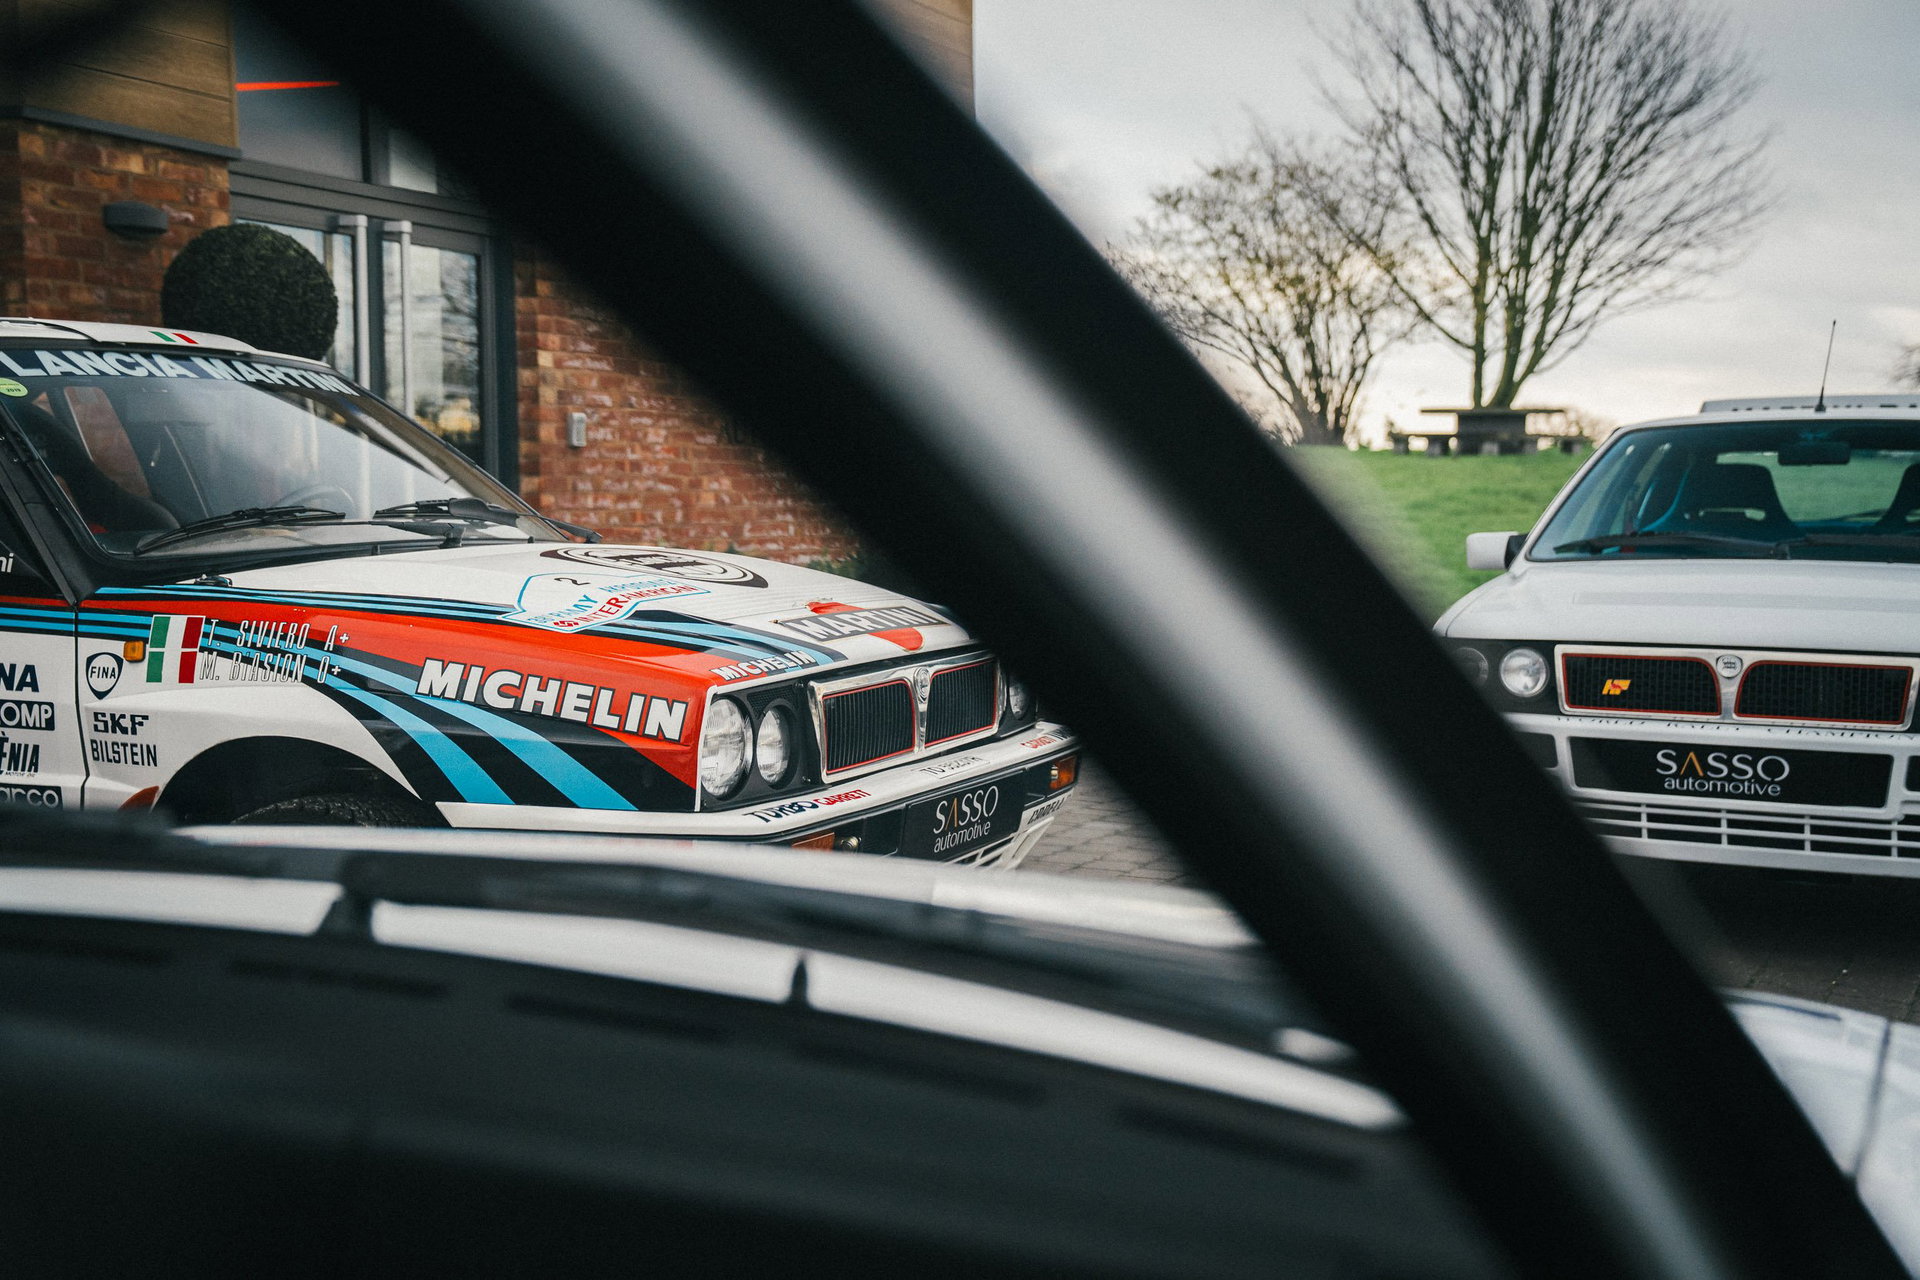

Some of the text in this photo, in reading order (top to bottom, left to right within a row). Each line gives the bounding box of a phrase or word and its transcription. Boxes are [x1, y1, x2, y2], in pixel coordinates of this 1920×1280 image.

[0, 350, 360, 396] LANCIA MARTINI
[207, 619, 349, 651] T. SIVIERO A+
[785, 608, 939, 639] MARTINI
[90, 666, 116, 679] FINA
[199, 651, 220, 680] M.
[709, 650, 818, 681] MICHELIN
[415, 657, 688, 743] MICHELIN
[93, 712, 149, 735] SKF
[90, 739, 158, 767] BILSTEIN
[1656, 749, 1790, 782] SASSO
[1664, 776, 1781, 796] automotive
[742, 800, 819, 823] TURBO
[933, 785, 999, 834] SASSO
[933, 819, 991, 853] automotive
